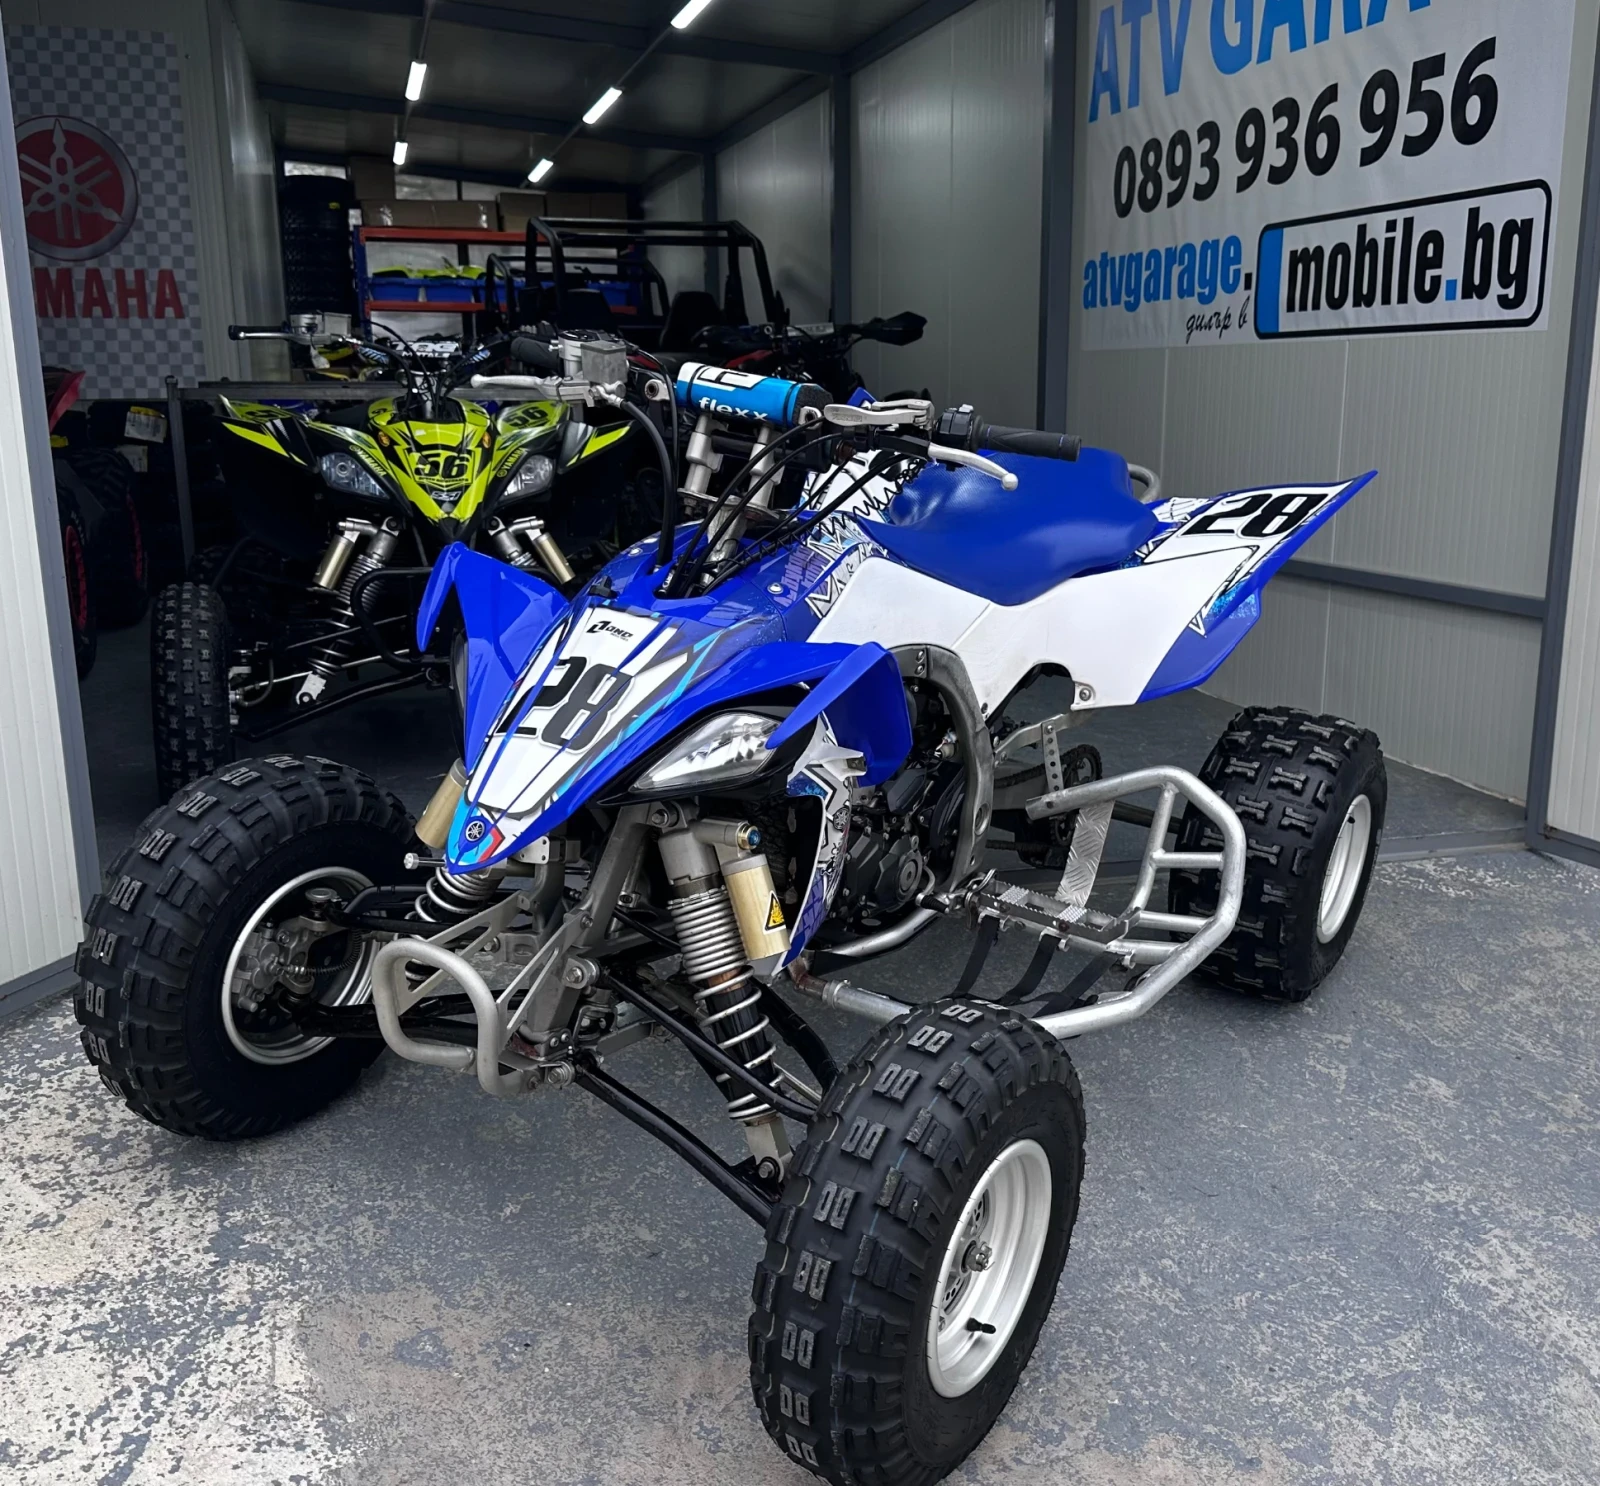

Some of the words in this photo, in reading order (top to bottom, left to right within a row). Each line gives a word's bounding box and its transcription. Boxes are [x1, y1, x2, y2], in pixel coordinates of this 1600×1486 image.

[1088, 0, 1193, 124] ATV
[1113, 121, 1221, 219] 0893
[1235, 82, 1341, 193] 936
[1359, 36, 1499, 167] 956
[1286, 206, 1534, 310] mobile.bg
[33, 267, 186, 319] MAHA
[1185, 306, 1232, 345] дилър
[698, 396, 769, 422] flexx
[413, 452, 469, 478] 56
[1179, 493, 1330, 538] 28
[495, 656, 634, 751] 28
